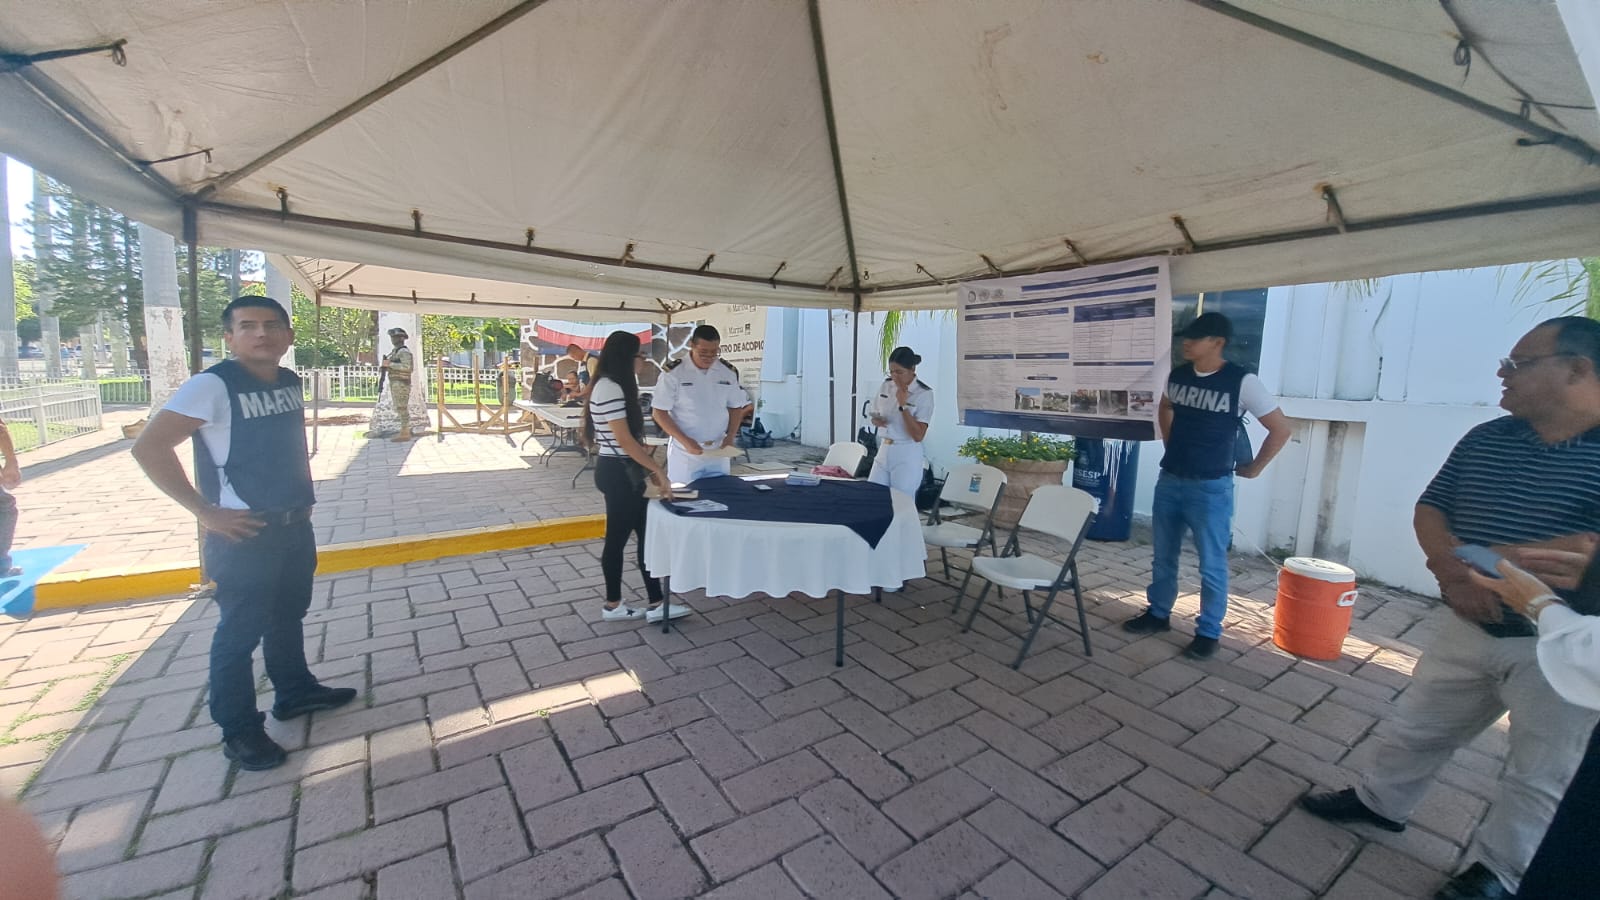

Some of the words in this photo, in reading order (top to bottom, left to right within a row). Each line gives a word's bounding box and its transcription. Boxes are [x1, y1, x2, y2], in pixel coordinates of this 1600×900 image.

[733, 342, 741, 352] DE
[238, 386, 303, 419] MARIN
[1169, 382, 1231, 413] MARINA
